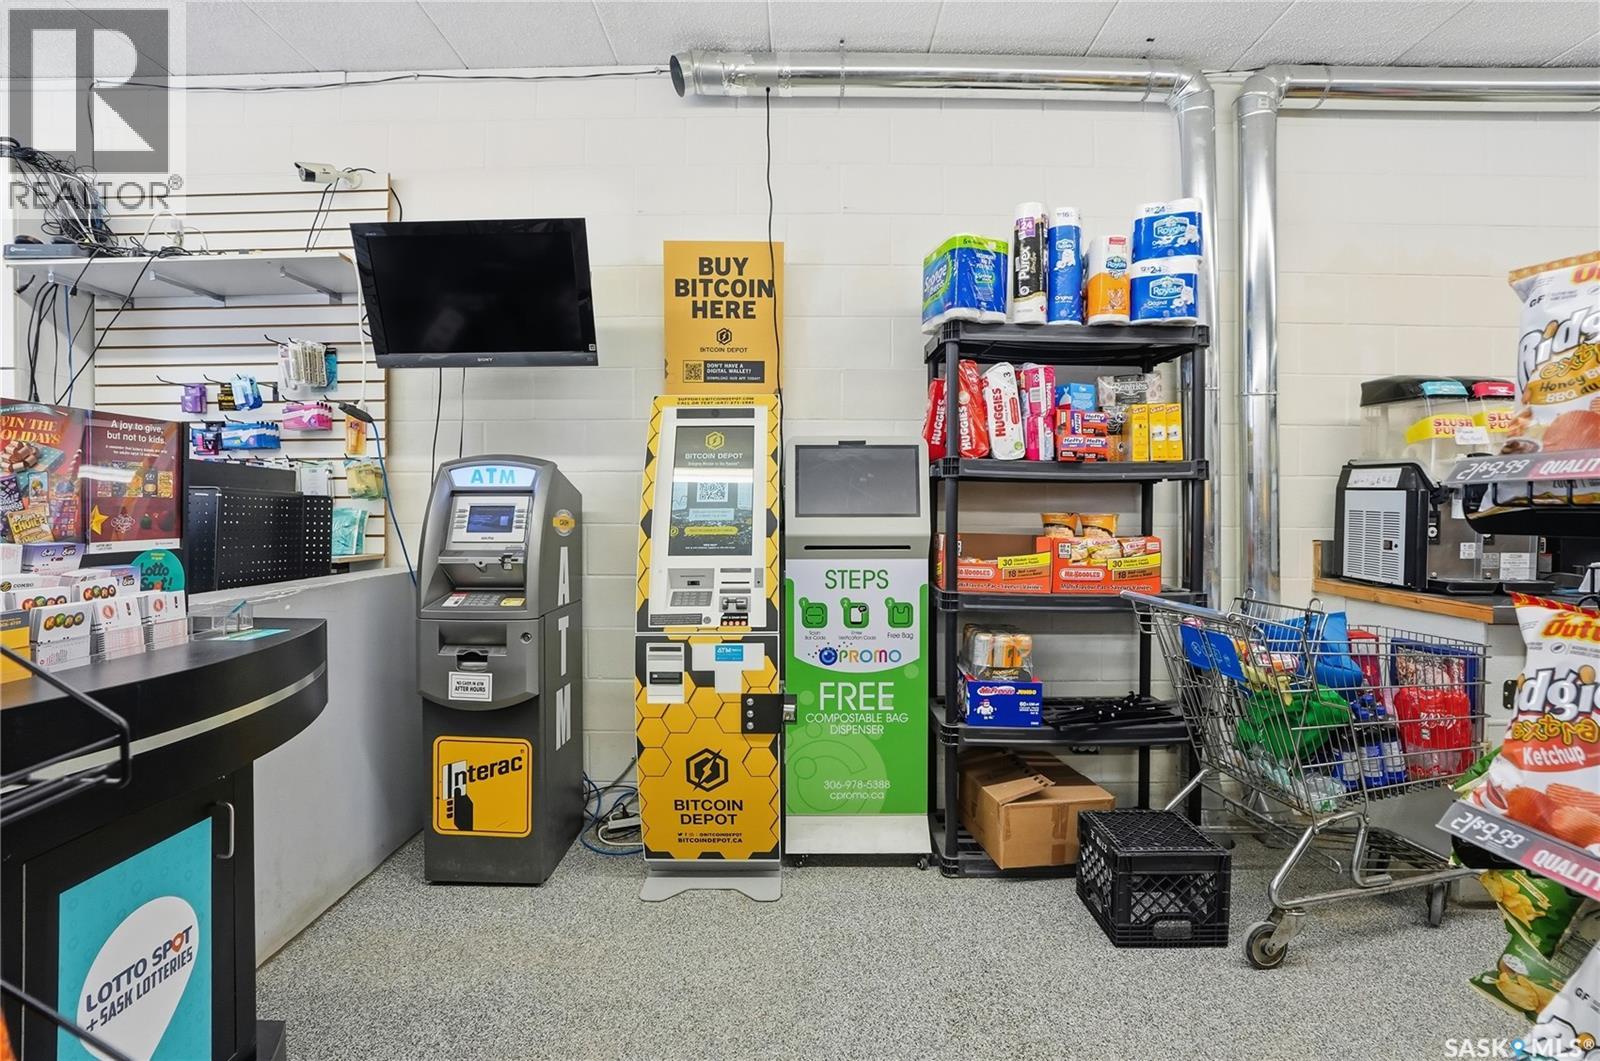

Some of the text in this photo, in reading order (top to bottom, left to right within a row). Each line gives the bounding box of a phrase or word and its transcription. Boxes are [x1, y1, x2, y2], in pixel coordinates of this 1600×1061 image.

[1020, 220, 1034, 230] 24
[698, 256, 749, 276] BUY
[1018, 245, 1032, 280] Purex
[674, 278, 775, 298] BITCOIN
[1152, 285, 1185, 298] Royale
[691, 300, 757, 319] HERE
[1539, 374, 1586, 393] Honey
[992, 387, 1006, 438] HUGGIES
[29, 418, 58, 432] THE
[111, 420, 164, 434] A joy to give,
[930, 398, 945, 446] HUGGIES
[959, 405, 972, 450] HUGGIES
[1434, 418, 1473, 427] SLUSH
[0, 429, 63, 446] OLIDAYS
[107, 431, 168, 445] but not to kids.
[471, 467, 516, 484] ATM
[140, 562, 170, 576] Lotto
[1002, 558, 1012, 566] 30
[1112, 560, 1123, 568] 30
[825, 569, 889, 590] STEPS
[1008, 570, 1017, 578] 18
[1118, 571, 1127, 579] 18
[901, 632, 914, 640] Bag
[819, 681, 895, 711] FREE
[805, 712, 909, 724] COMPOSTABLE BAG
[830, 725, 885, 735] DISPENSER
[1511, 714, 1600, 746] extra
[1523, 744, 1586, 766] Ketchup
[823, 780, 891, 790] 306-978-5388
[829, 791, 885, 801] cpromo.ca
[674, 800, 744, 811] BITCOIN
[680, 814, 738, 825] DEPOT
[86, 925, 193, 1013] LOTTO SPOT
[100, 989, 133, 1027] SASK
[136, 946, 193, 1001] LOTTERIES
